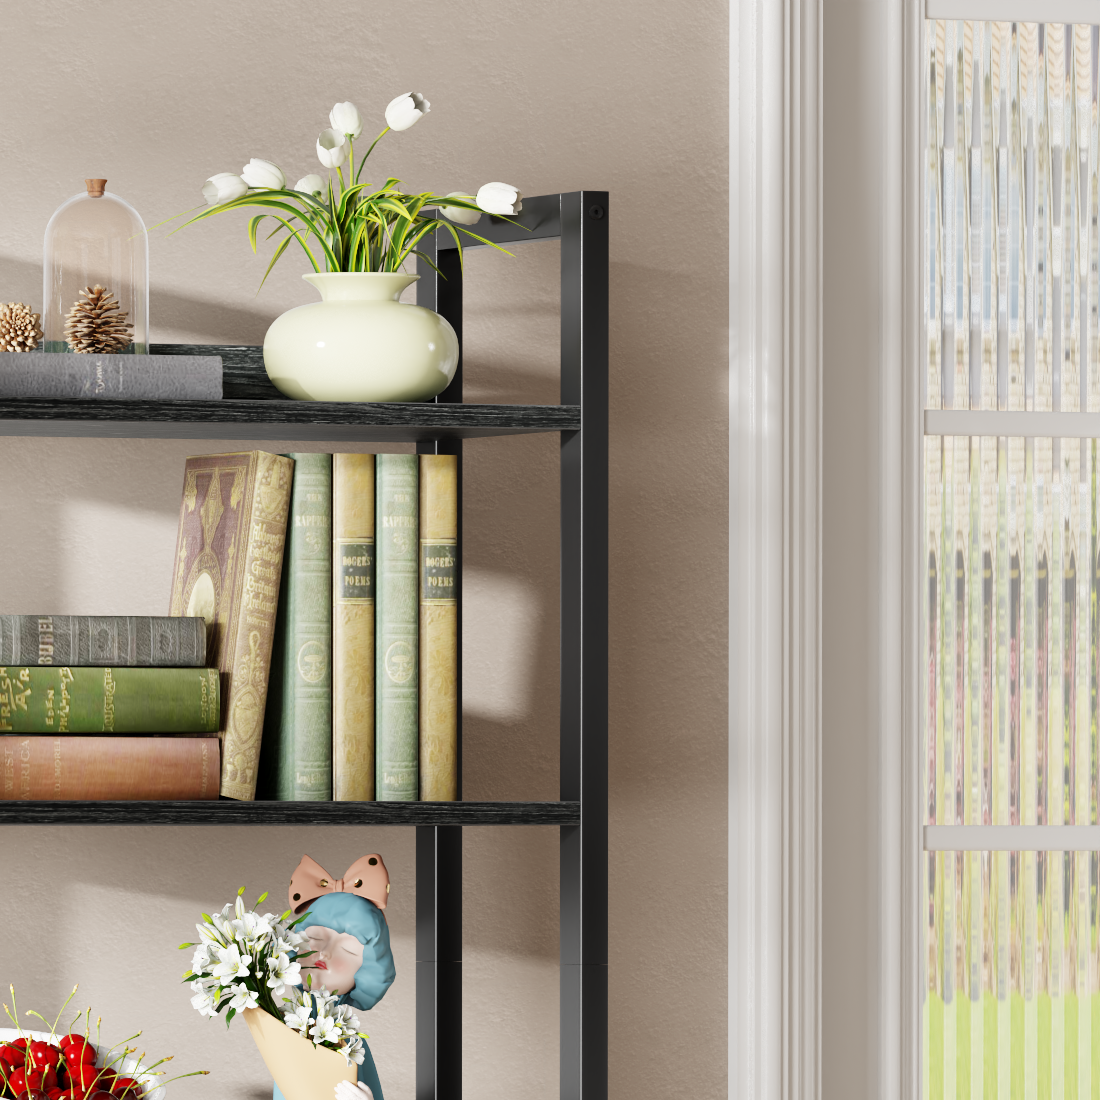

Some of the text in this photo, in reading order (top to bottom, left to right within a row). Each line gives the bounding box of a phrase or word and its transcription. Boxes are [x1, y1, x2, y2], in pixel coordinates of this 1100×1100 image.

[344, 575, 371, 587] POEMS
[427, 576, 454, 588] POEMS
[4, 746, 14, 792] WEST
